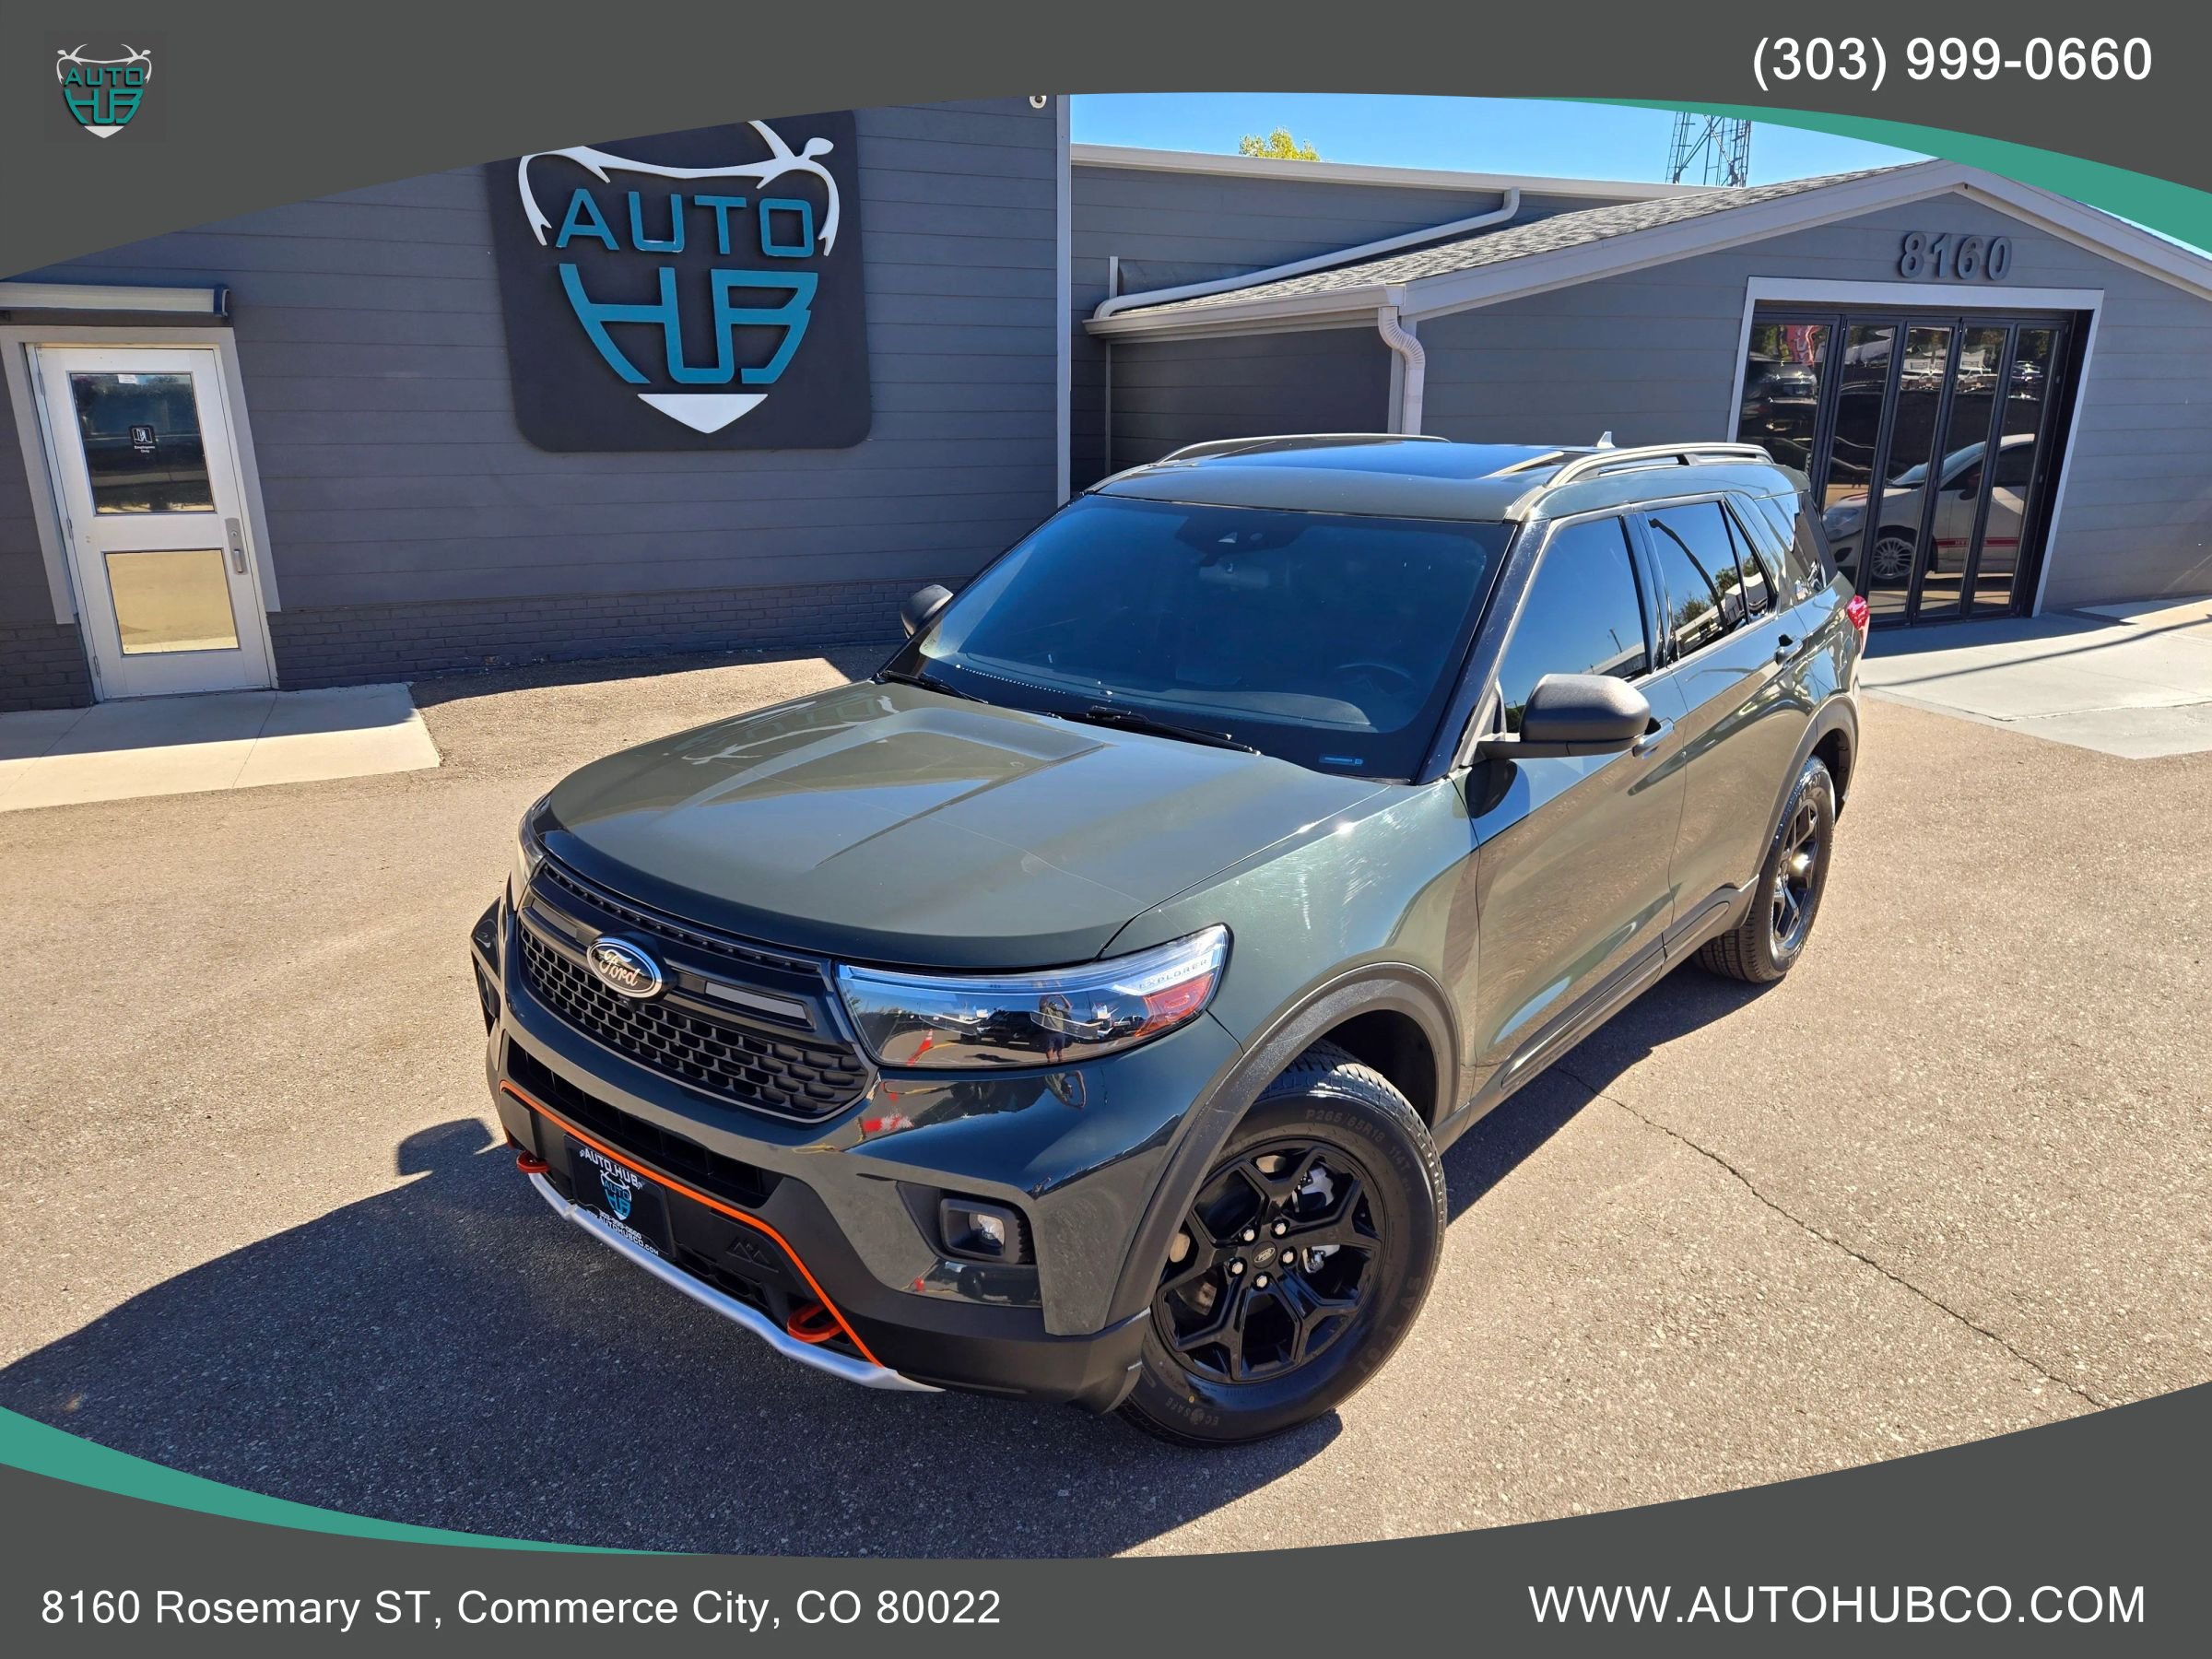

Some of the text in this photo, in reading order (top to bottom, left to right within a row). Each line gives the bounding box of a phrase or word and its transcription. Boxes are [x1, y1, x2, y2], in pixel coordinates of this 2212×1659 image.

[556, 188, 815, 257] AUTO
[1899, 231, 2012, 280] 8160
[559, 263, 818, 383] HUB
[599, 948, 638, 986] Ford
[1139, 959, 1207, 989] EXPLORER
[584, 1147, 639, 1187] AUTO HUB
[604, 1180, 630, 1201] AUTO
